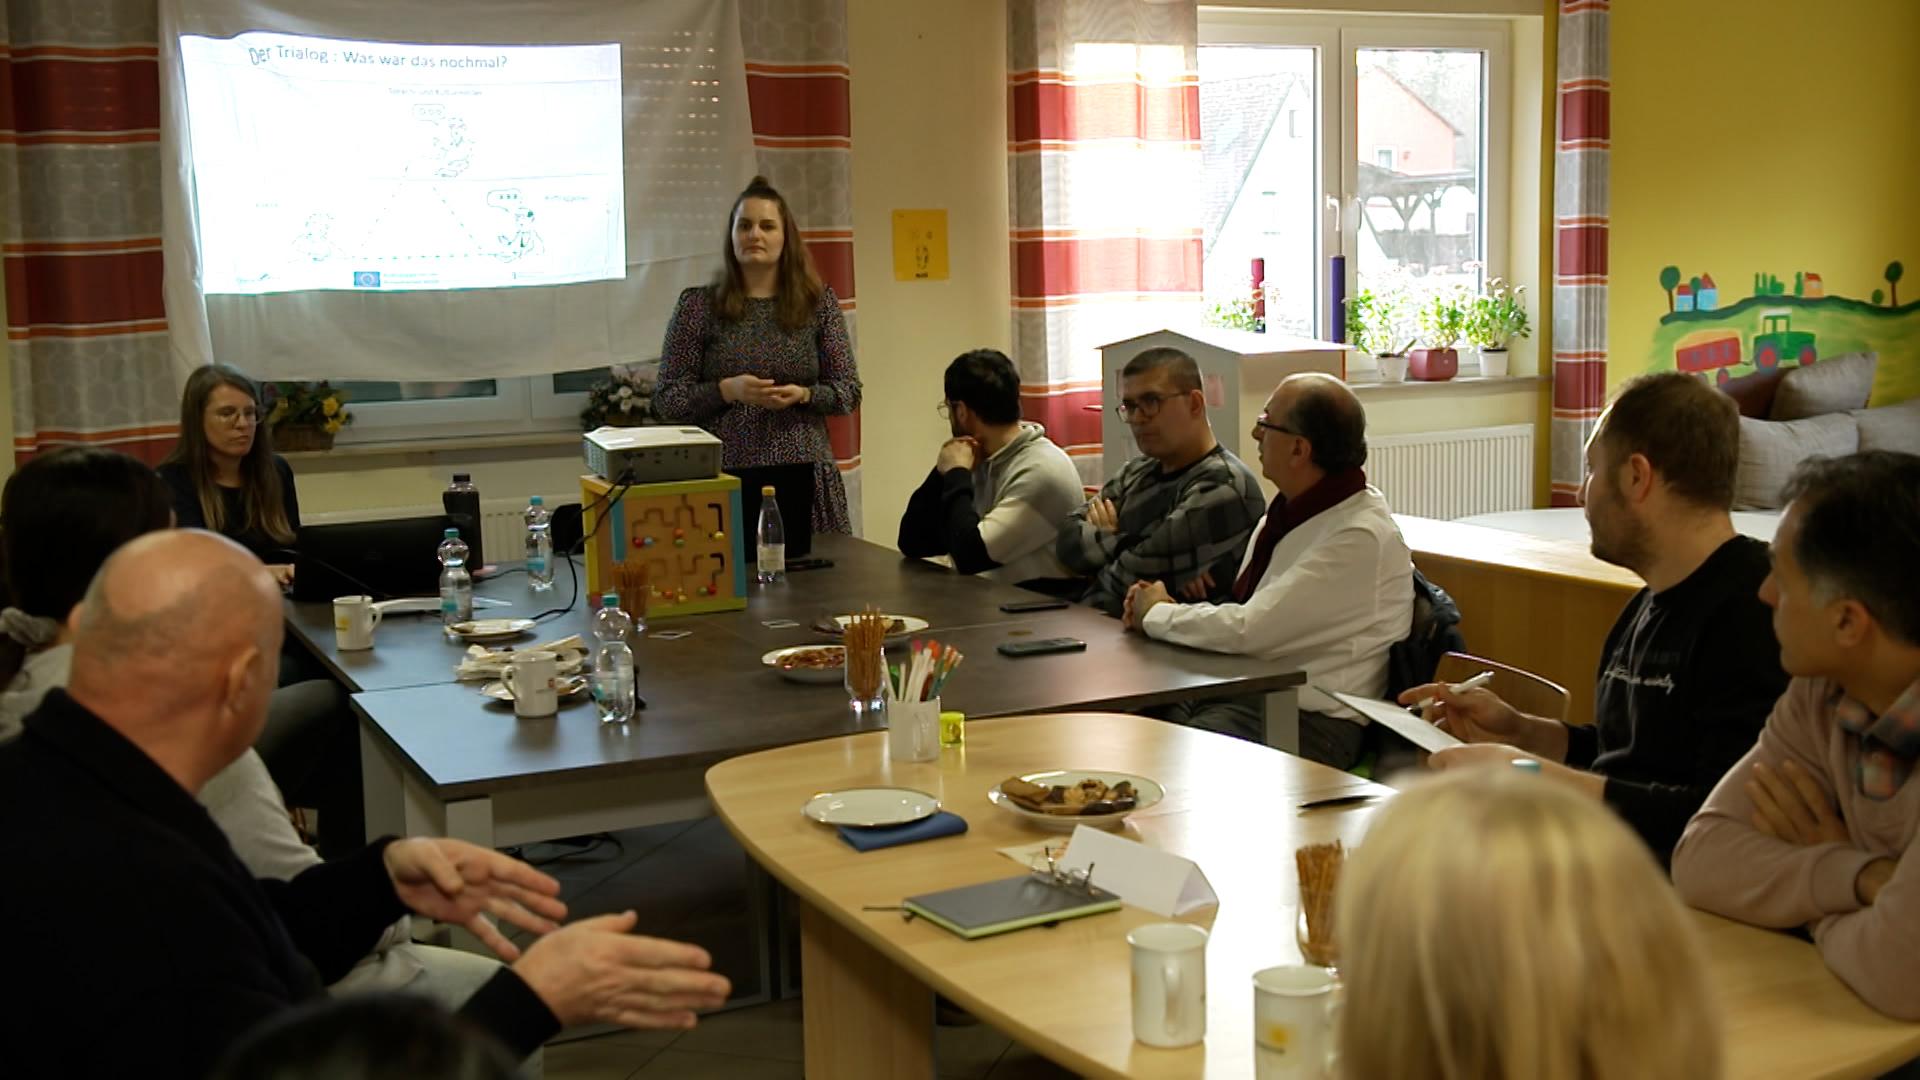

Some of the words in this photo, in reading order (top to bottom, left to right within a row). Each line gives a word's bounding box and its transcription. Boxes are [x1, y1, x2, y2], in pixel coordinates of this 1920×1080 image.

[249, 47, 271, 65] Der
[277, 45, 328, 64] Trialog
[343, 51, 375, 65] Was
[379, 54, 407, 66] war
[411, 55, 435, 68] das
[440, 55, 508, 70] nochmal?
